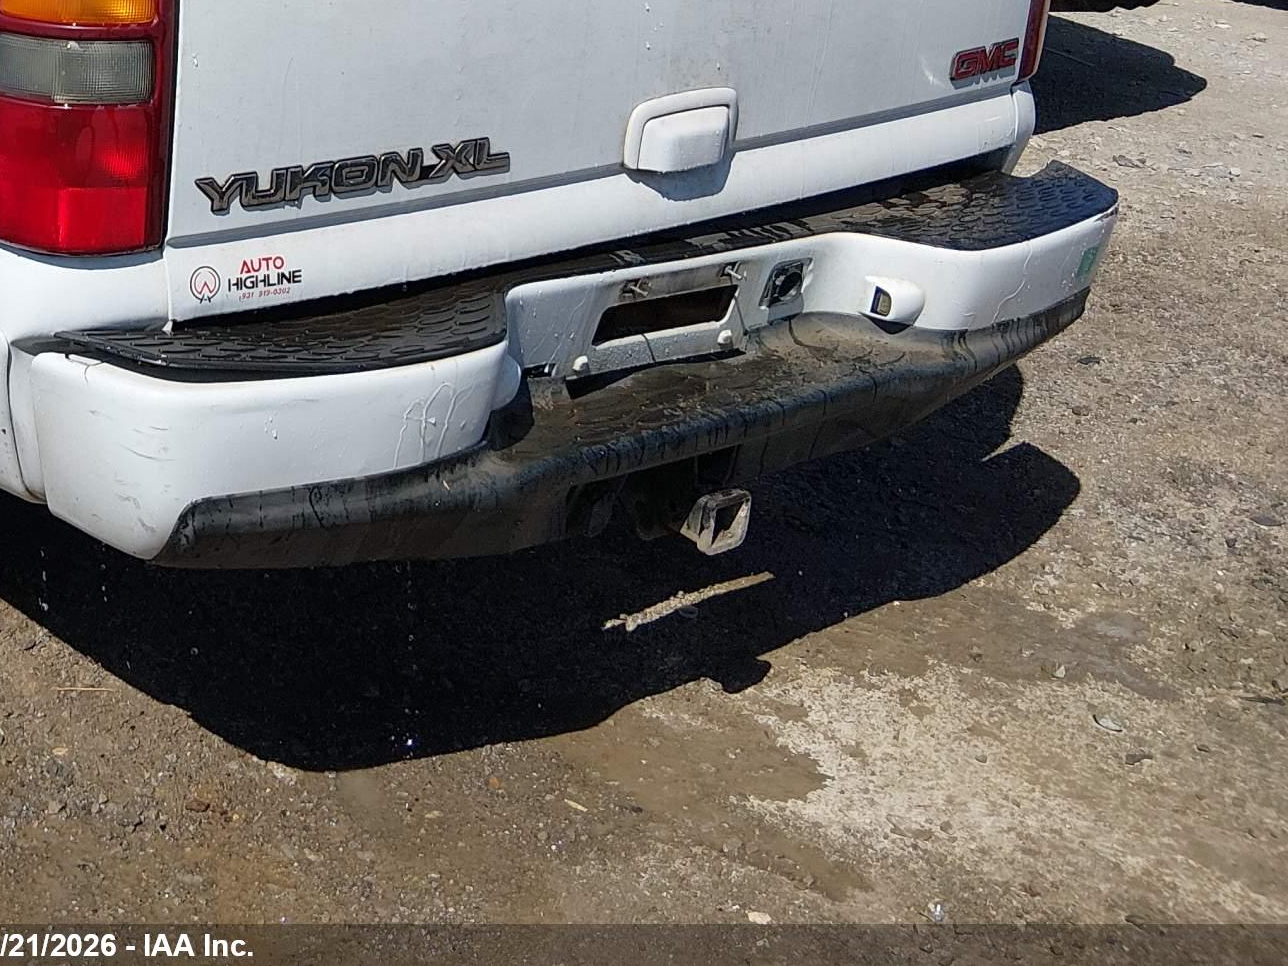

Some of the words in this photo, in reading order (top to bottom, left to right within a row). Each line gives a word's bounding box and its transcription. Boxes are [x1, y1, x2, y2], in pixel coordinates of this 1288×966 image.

[950, 37, 1019, 80] GMC
[195, 148, 423, 212] YUKON
[431, 137, 510, 178] XL
[228, 269, 302, 292] HIGHLINE
[240, 256, 285, 274] AUTO
